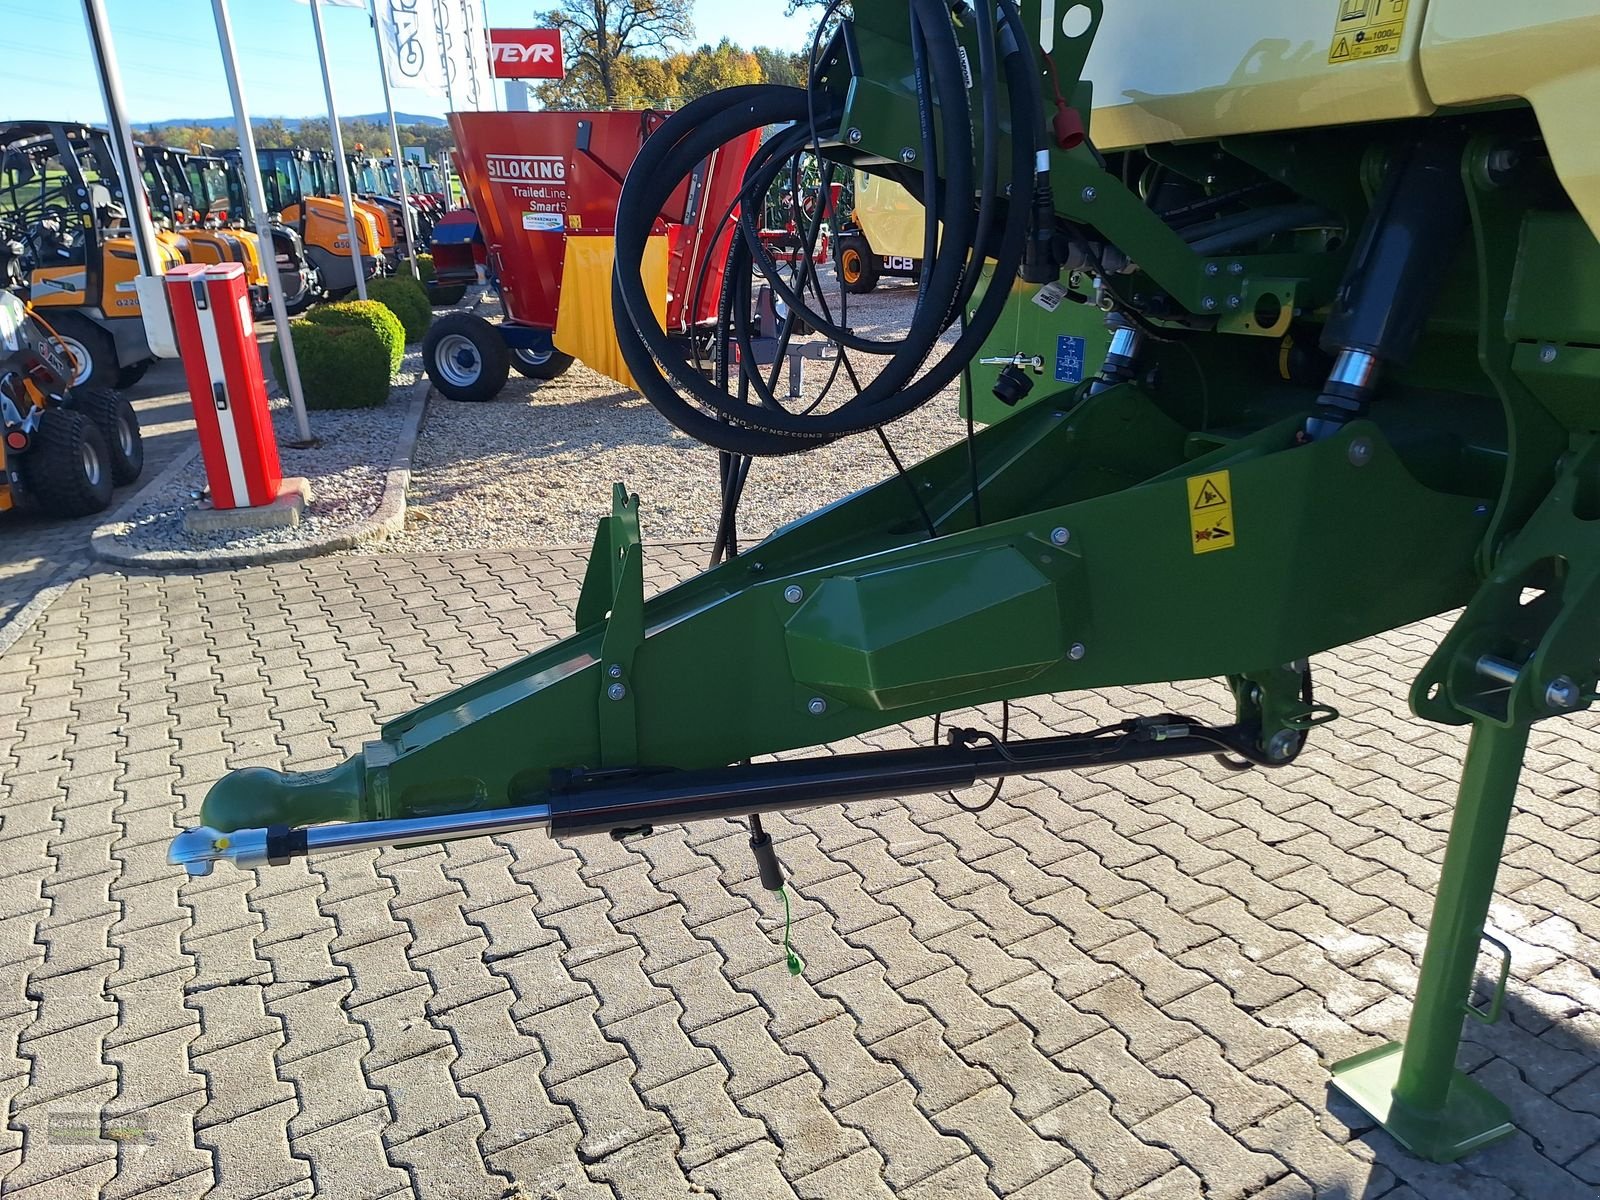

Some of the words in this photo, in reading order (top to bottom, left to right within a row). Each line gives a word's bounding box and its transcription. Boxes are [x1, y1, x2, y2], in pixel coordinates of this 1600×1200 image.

[487, 43, 554, 63] TEYR
[1373, 44, 1388, 54] 200
[487, 160, 565, 179] SILOKING
[512, 186, 566, 198] TrailedLine
[883, 255, 914, 271] JCB
